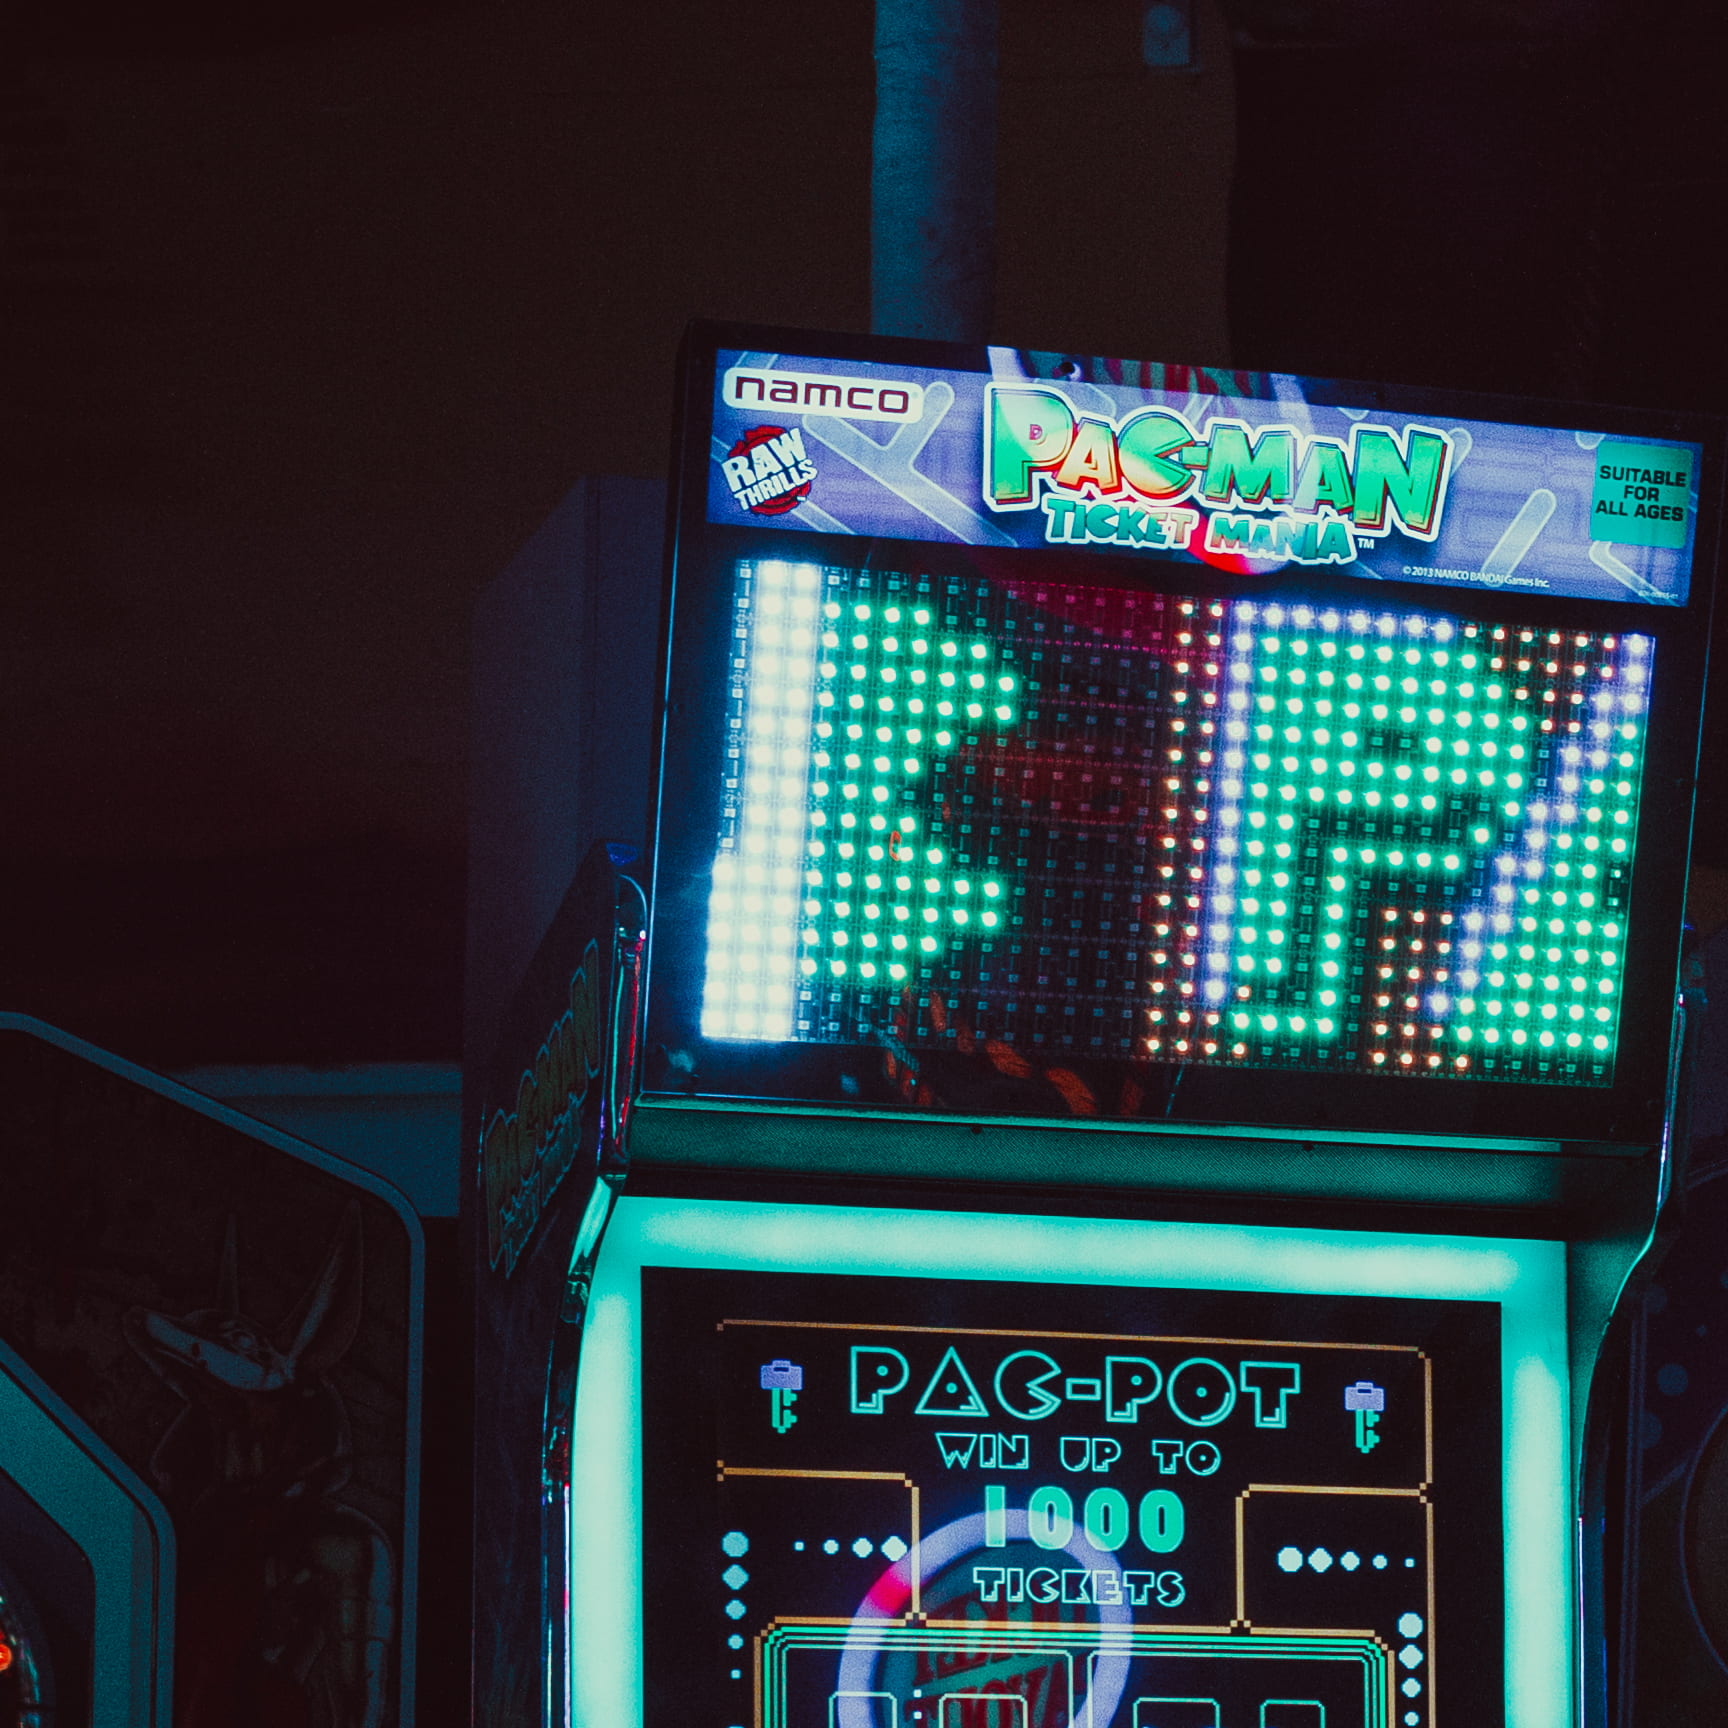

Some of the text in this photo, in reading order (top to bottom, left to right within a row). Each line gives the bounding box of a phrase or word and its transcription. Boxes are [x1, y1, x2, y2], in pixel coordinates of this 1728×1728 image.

[735, 376, 909, 415] namco
[722, 427, 807, 492] RAW
[988, 385, 1452, 538] PAC-MAN
[1599, 464, 1687, 488] SUITABLE
[733, 458, 818, 511] THRILLS
[1624, 485, 1660, 502] FOR
[1046, 498, 1195, 546] TICKET
[1209, 515, 1353, 561] MANIA
[1595, 499, 1684, 522] ALL AGES
[1411, 566, 1434, 578] 2013
[1434, 568, 1469, 581] NAMCO
[1469, 571, 1504, 584] BANDAI
[1503, 575, 1534, 586] Games
[849, 1346, 1301, 1429] PAC-POT
[935, 1432, 1222, 1476] WIN UP TO
[983, 1485, 1186, 1553] 1000
[972, 1566, 1186, 1608] TICKETS
